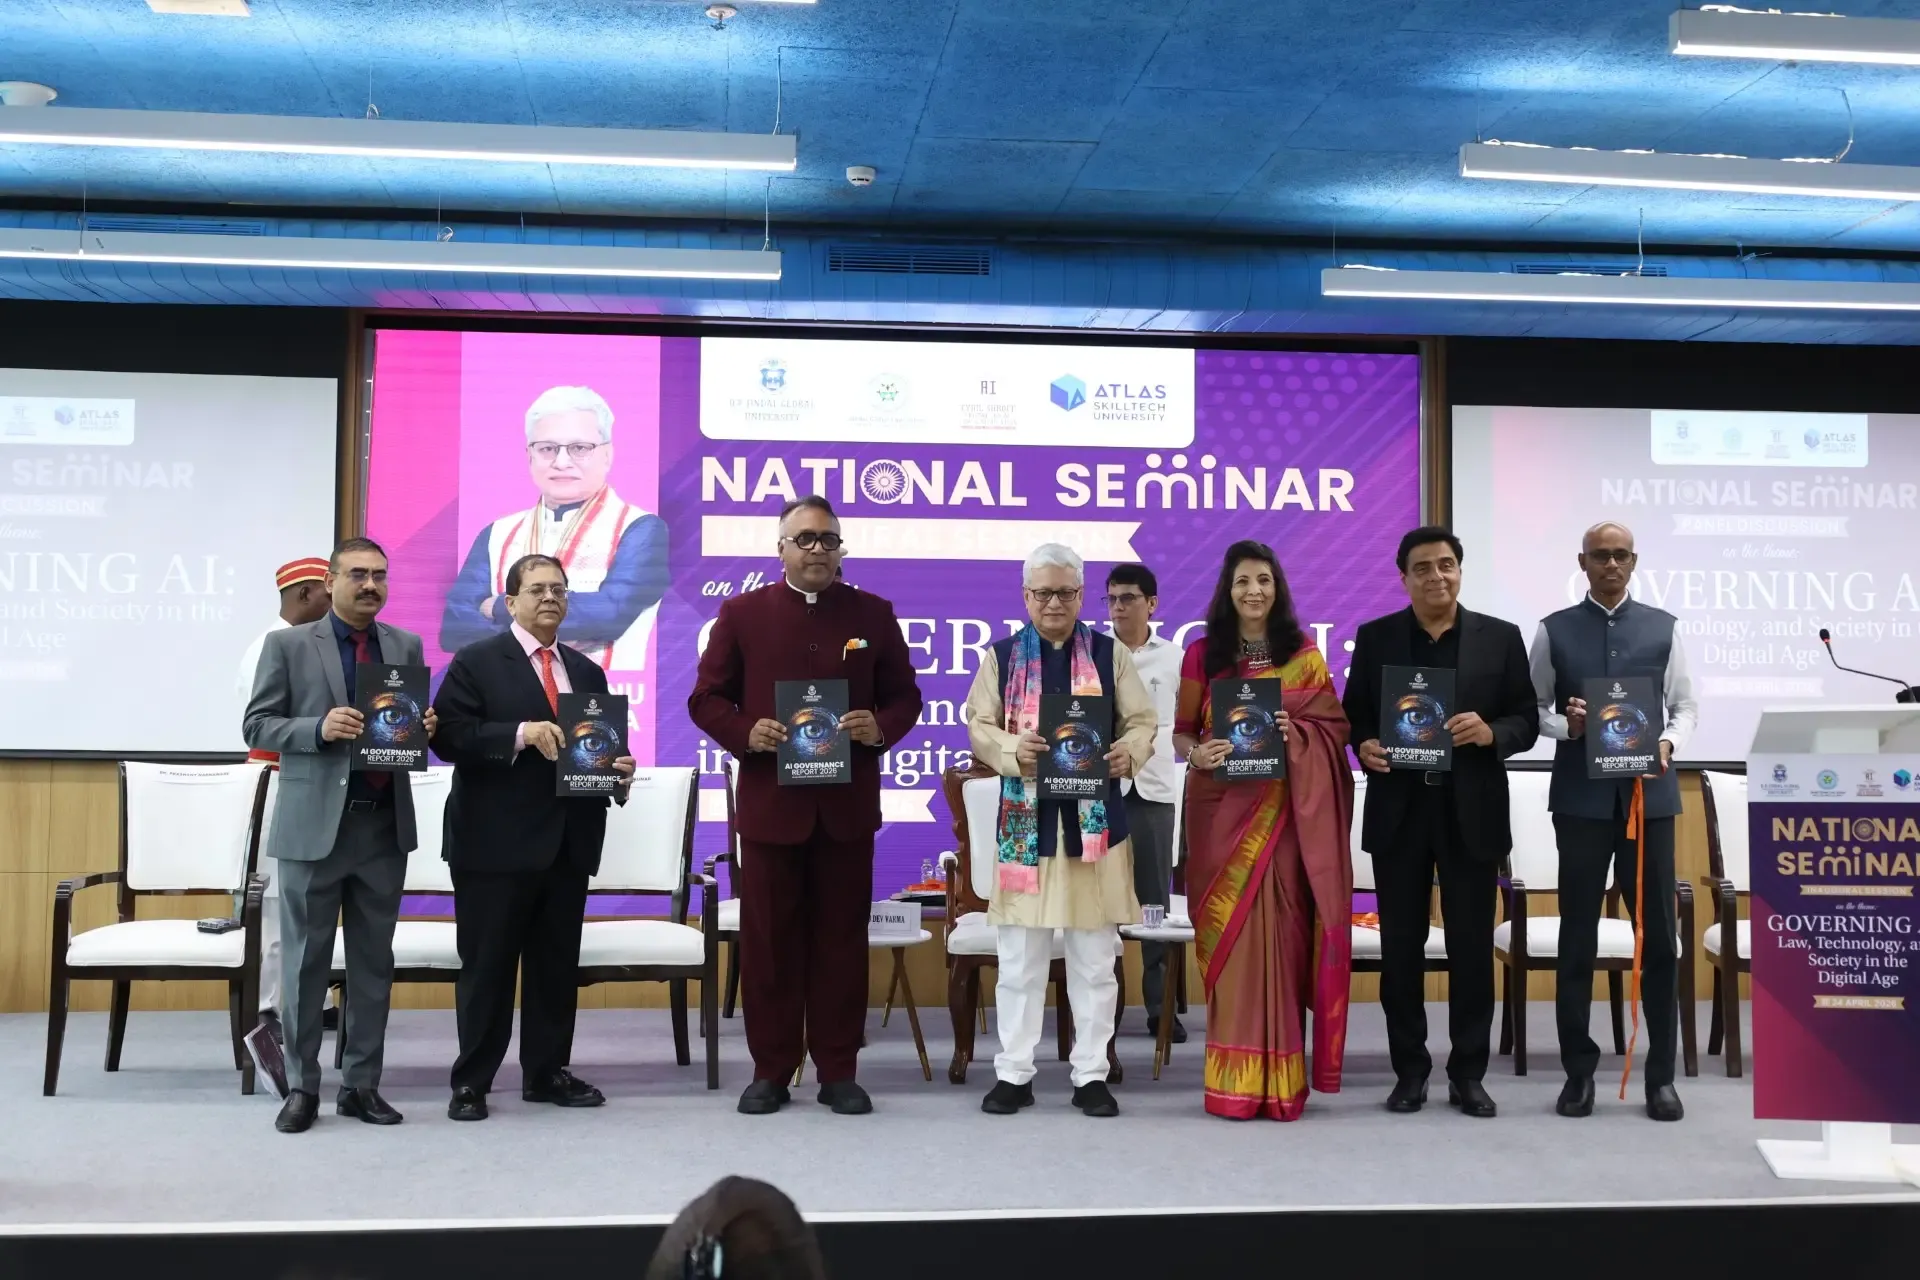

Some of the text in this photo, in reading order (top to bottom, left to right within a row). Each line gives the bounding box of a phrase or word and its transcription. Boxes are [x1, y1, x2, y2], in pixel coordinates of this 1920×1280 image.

[1094, 383, 1167, 399] ATLAS
[1093, 401, 1166, 412] SKILLTECH
[1093, 412, 1165, 421] UNIVERSITY
[702, 456, 1028, 507] NATIONAL
[1601, 477, 1758, 507] NATIONAL
[702, 580, 734, 597] on
[1762, 615, 1803, 637] and
[1892, 617, 1911, 637] in
[15, 628, 67, 656] Age
[1704, 643, 1820, 671] Digital Age
[370, 748, 422, 757] GOVERNANCE
[1392, 753, 1438, 762] REPORT 2026
[1394, 747, 1445, 756] GOVERNANCE
[396, 755, 415, 763] 2026
[793, 761, 845, 769] GOVERNANCE
[1603, 755, 1655, 763] GOVERNANCE
[1052, 777, 1104, 786] GOVERNANCE
[872, 914, 884, 923] DEV
[1767, 914, 1912, 934] GOVERNING
[1778, 936, 1812, 950] Law,
[1815, 936, 1906, 953] Technology,
[1808, 953, 1908, 970] Society in the
[1818, 970, 1899, 988] Digital Age
[1845, 998, 1871, 1008] APRIL
